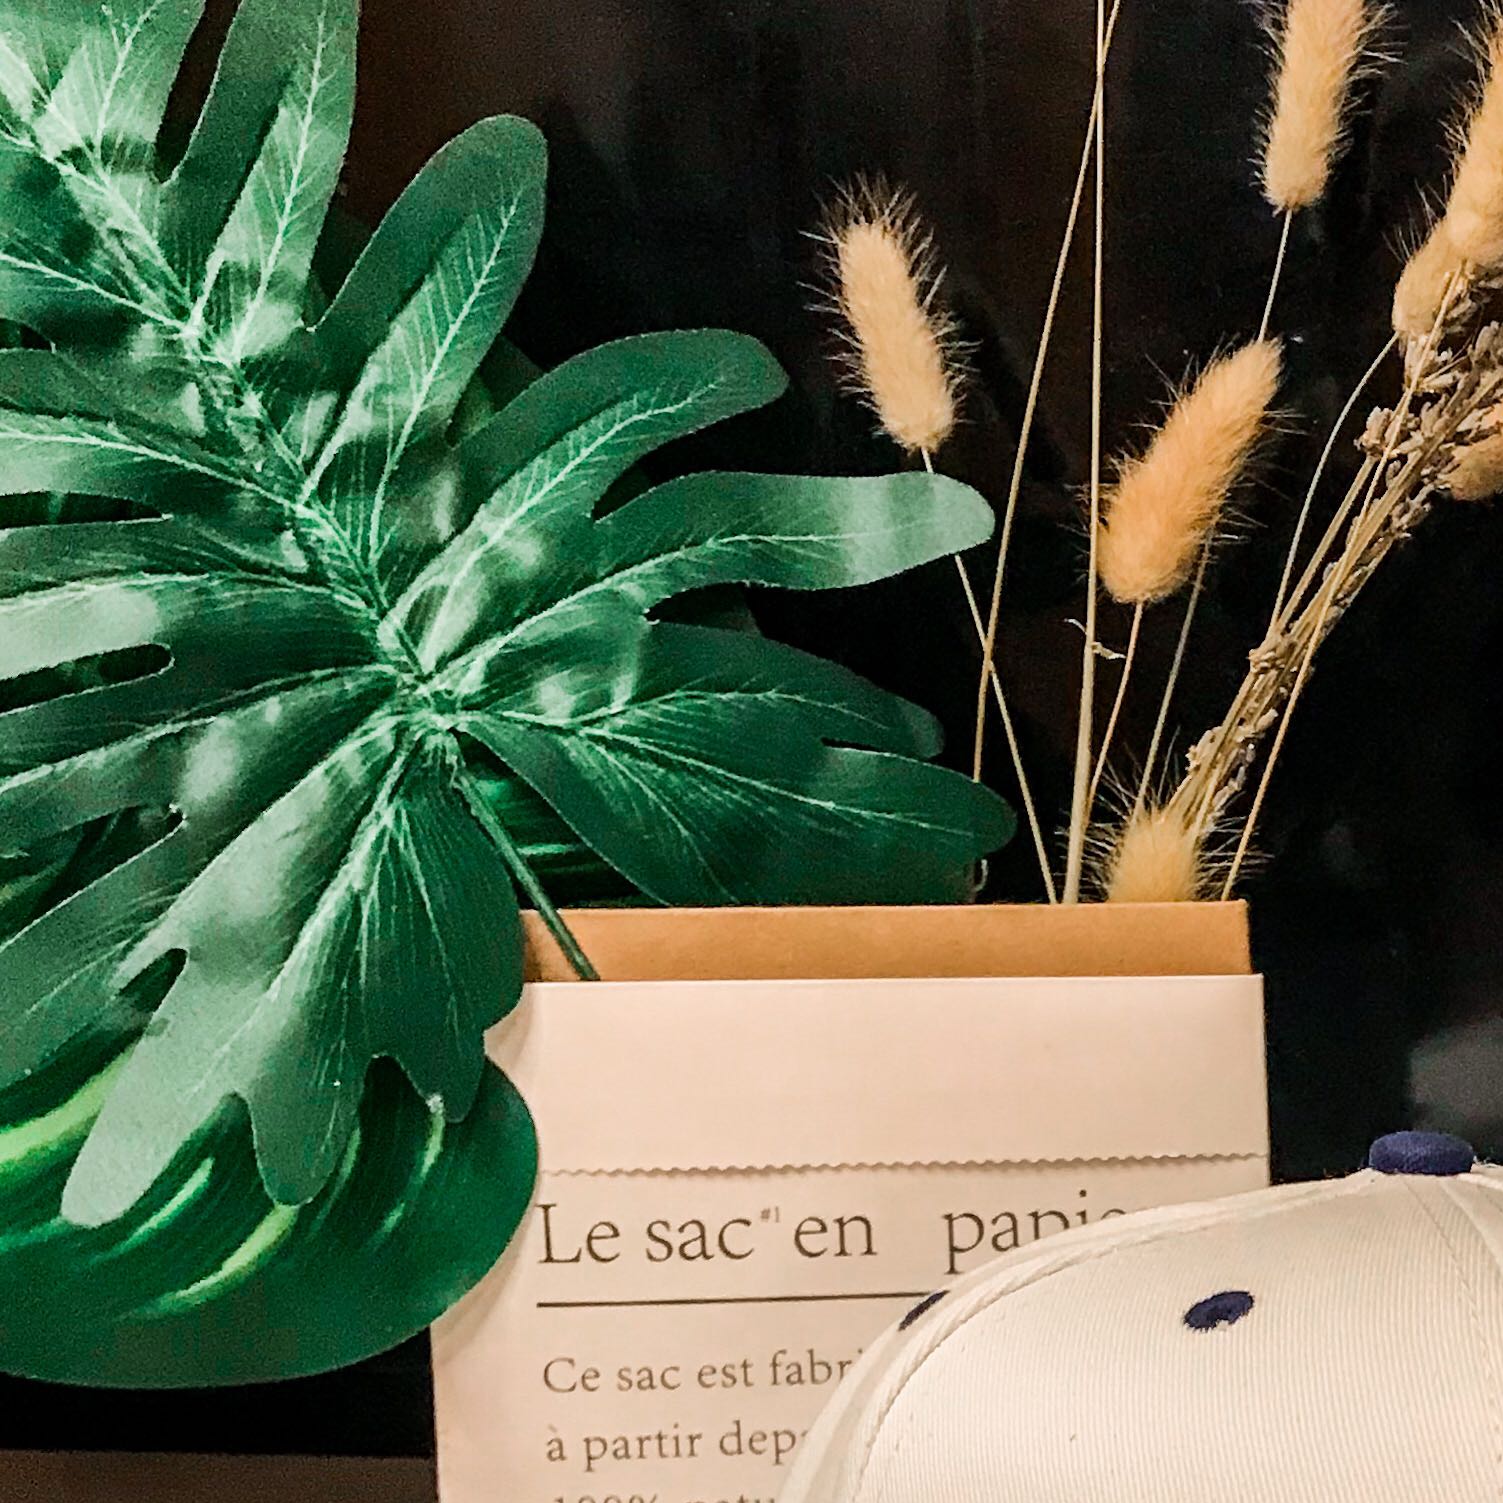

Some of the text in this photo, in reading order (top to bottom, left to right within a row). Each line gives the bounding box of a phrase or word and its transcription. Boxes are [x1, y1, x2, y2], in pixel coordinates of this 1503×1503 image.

[537, 1203, 621, 1264] Le
[645, 1218, 755, 1262] sac
[793, 1214, 878, 1258] en
[543, 1349, 864, 1393] Ce sac est fabr
[546, 1419, 810, 1473] à partir dep
